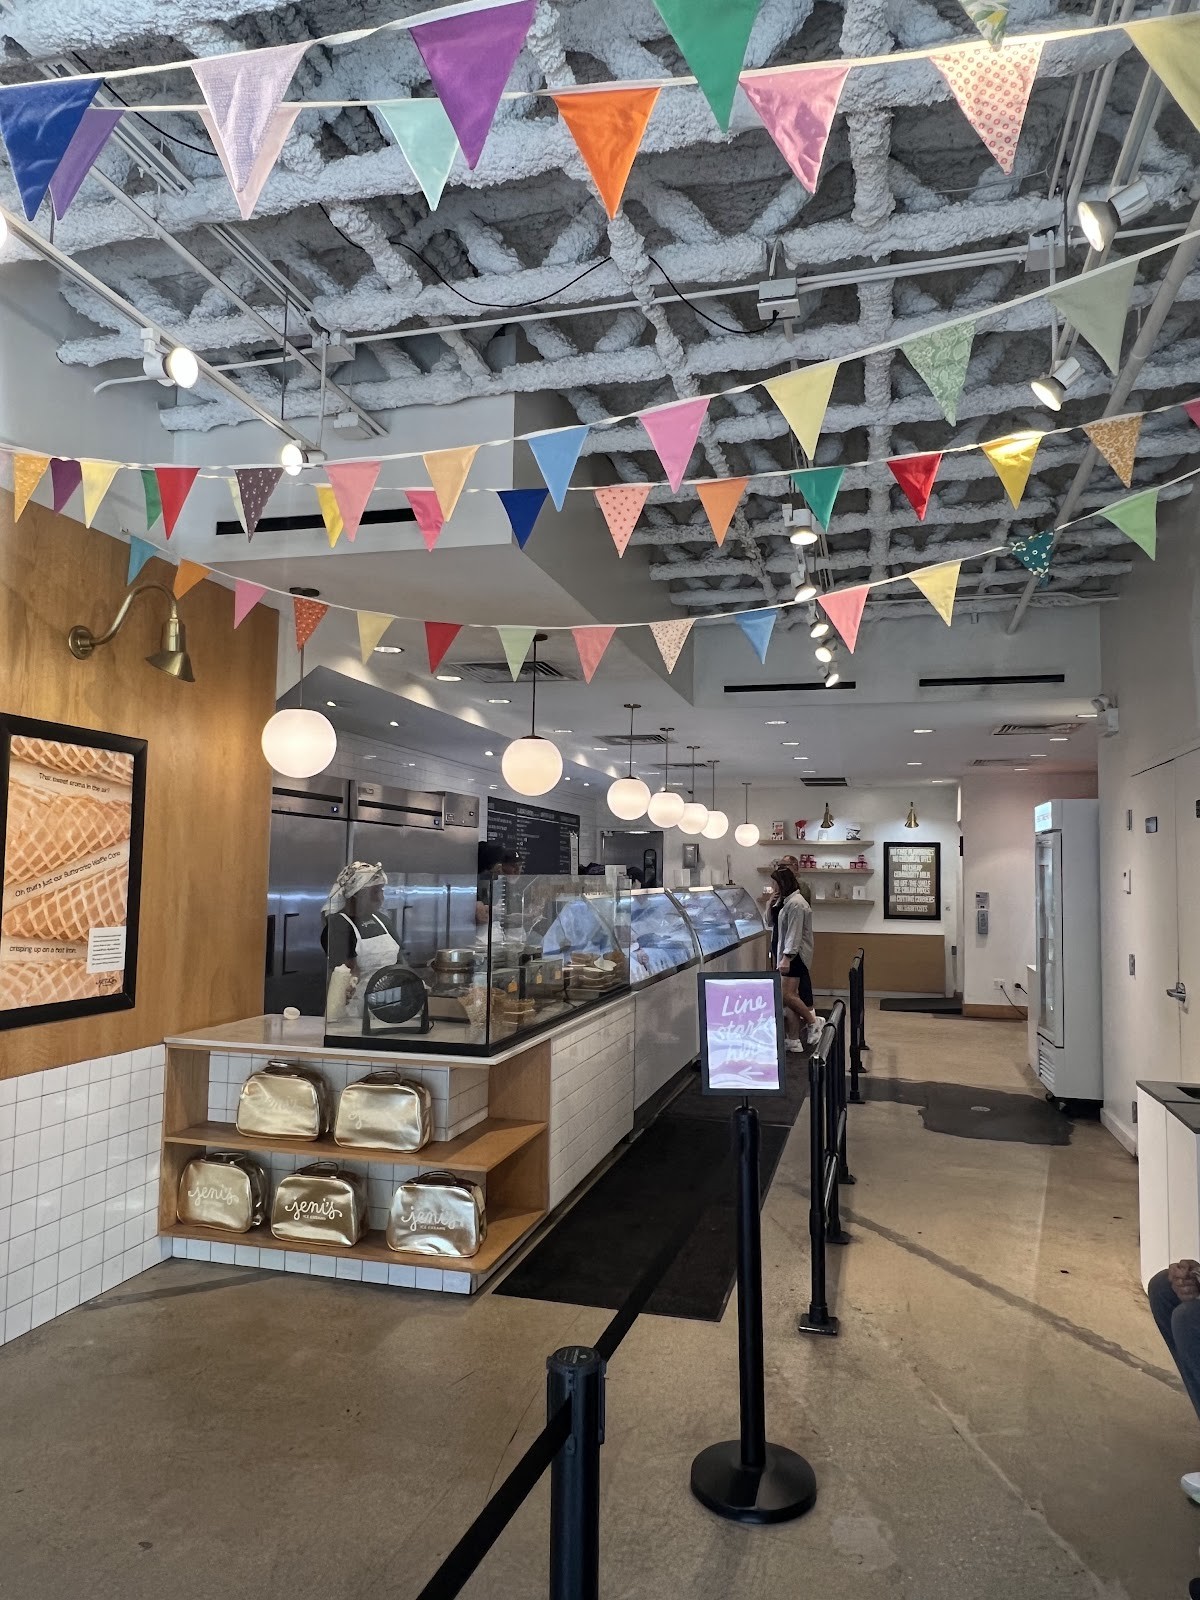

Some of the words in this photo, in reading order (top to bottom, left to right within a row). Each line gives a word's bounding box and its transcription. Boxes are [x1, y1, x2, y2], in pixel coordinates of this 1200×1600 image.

[69, 780, 86, 789] aroma
[15, 889, 25, 897] Oh
[26, 882, 41, 894] that's
[42, 878, 53, 889] just
[53, 874, 63, 882] our
[92, 856, 108, 866] Waffle
[108, 850, 121, 860] Cone
[9, 946, 32, 954] crisping
[721, 995, 767, 1017] Line
[717, 1013, 776, 1041] starts
[187, 1182, 240, 1206] jeni's
[284, 1196, 343, 1221] jeni's
[400, 1205, 464, 1232] jeni's
